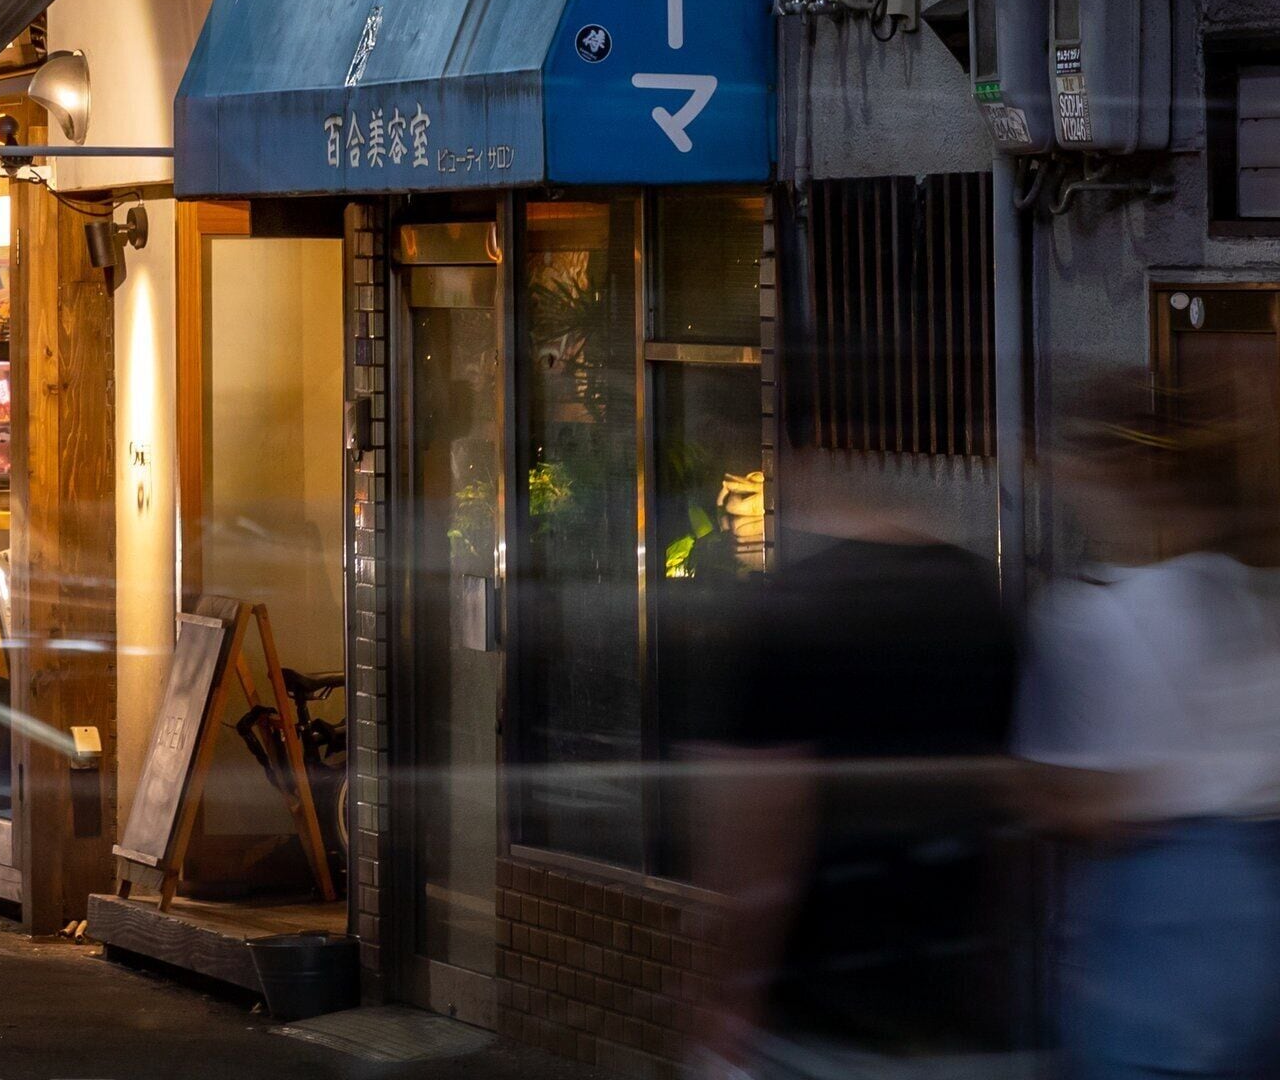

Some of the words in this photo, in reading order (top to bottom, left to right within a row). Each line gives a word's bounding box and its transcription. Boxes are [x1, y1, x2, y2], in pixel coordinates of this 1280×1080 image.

[324, 102, 431, 169] 百合美容室
[488, 146, 515, 170] サロン
